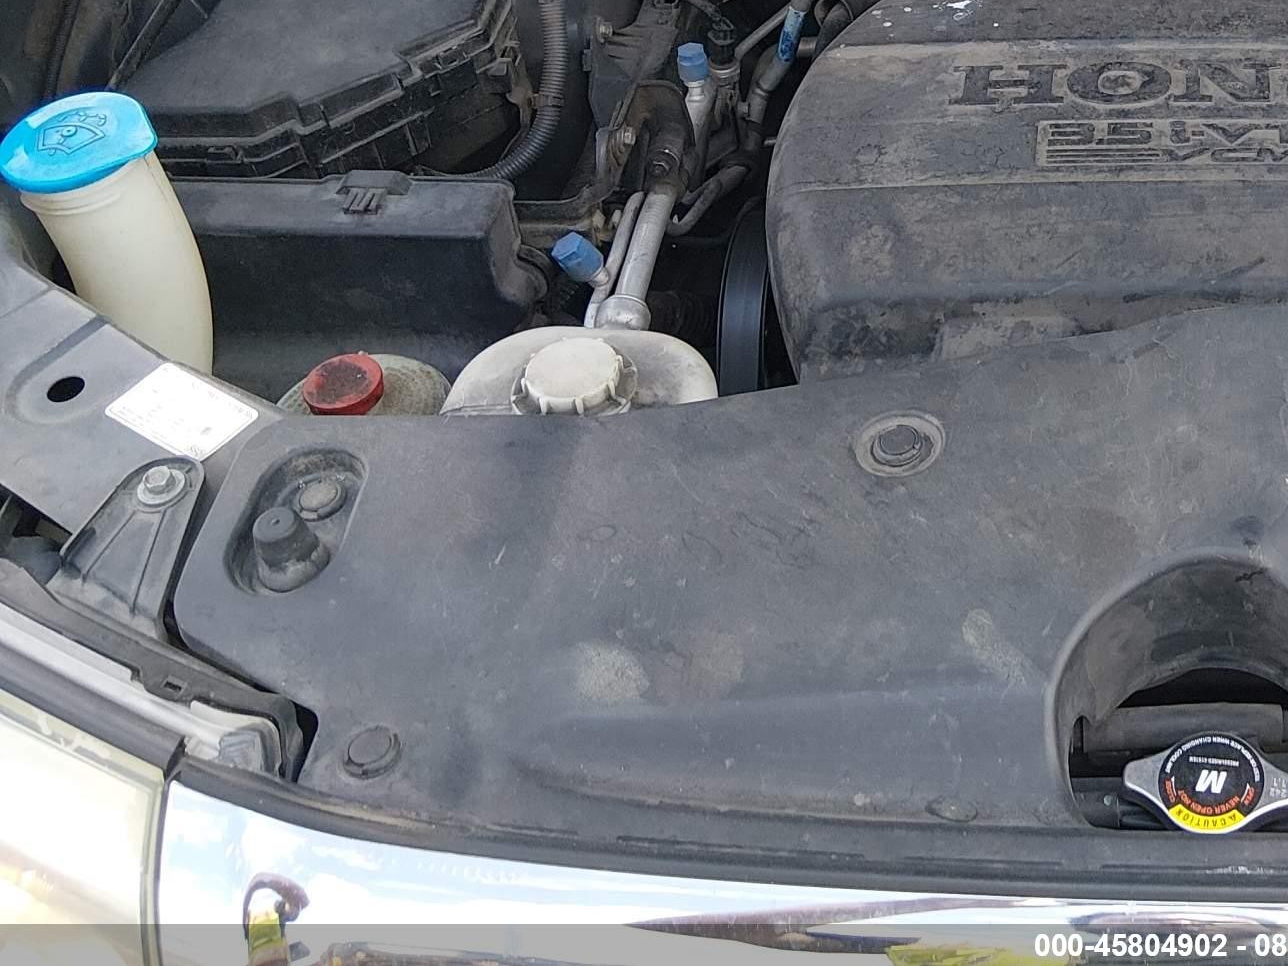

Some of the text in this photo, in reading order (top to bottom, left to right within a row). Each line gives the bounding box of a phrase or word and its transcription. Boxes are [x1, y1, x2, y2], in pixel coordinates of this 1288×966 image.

[1047, 121, 1154, 146] 3.5
[1181, 736, 1212, 750] CHANGING
[1212, 736, 1230, 745] WHEN
[1195, 769, 1228, 794] M
[1177, 789, 1240, 815] NEVER OPEN HOT
[1175, 808, 1226, 828] CAUTION
